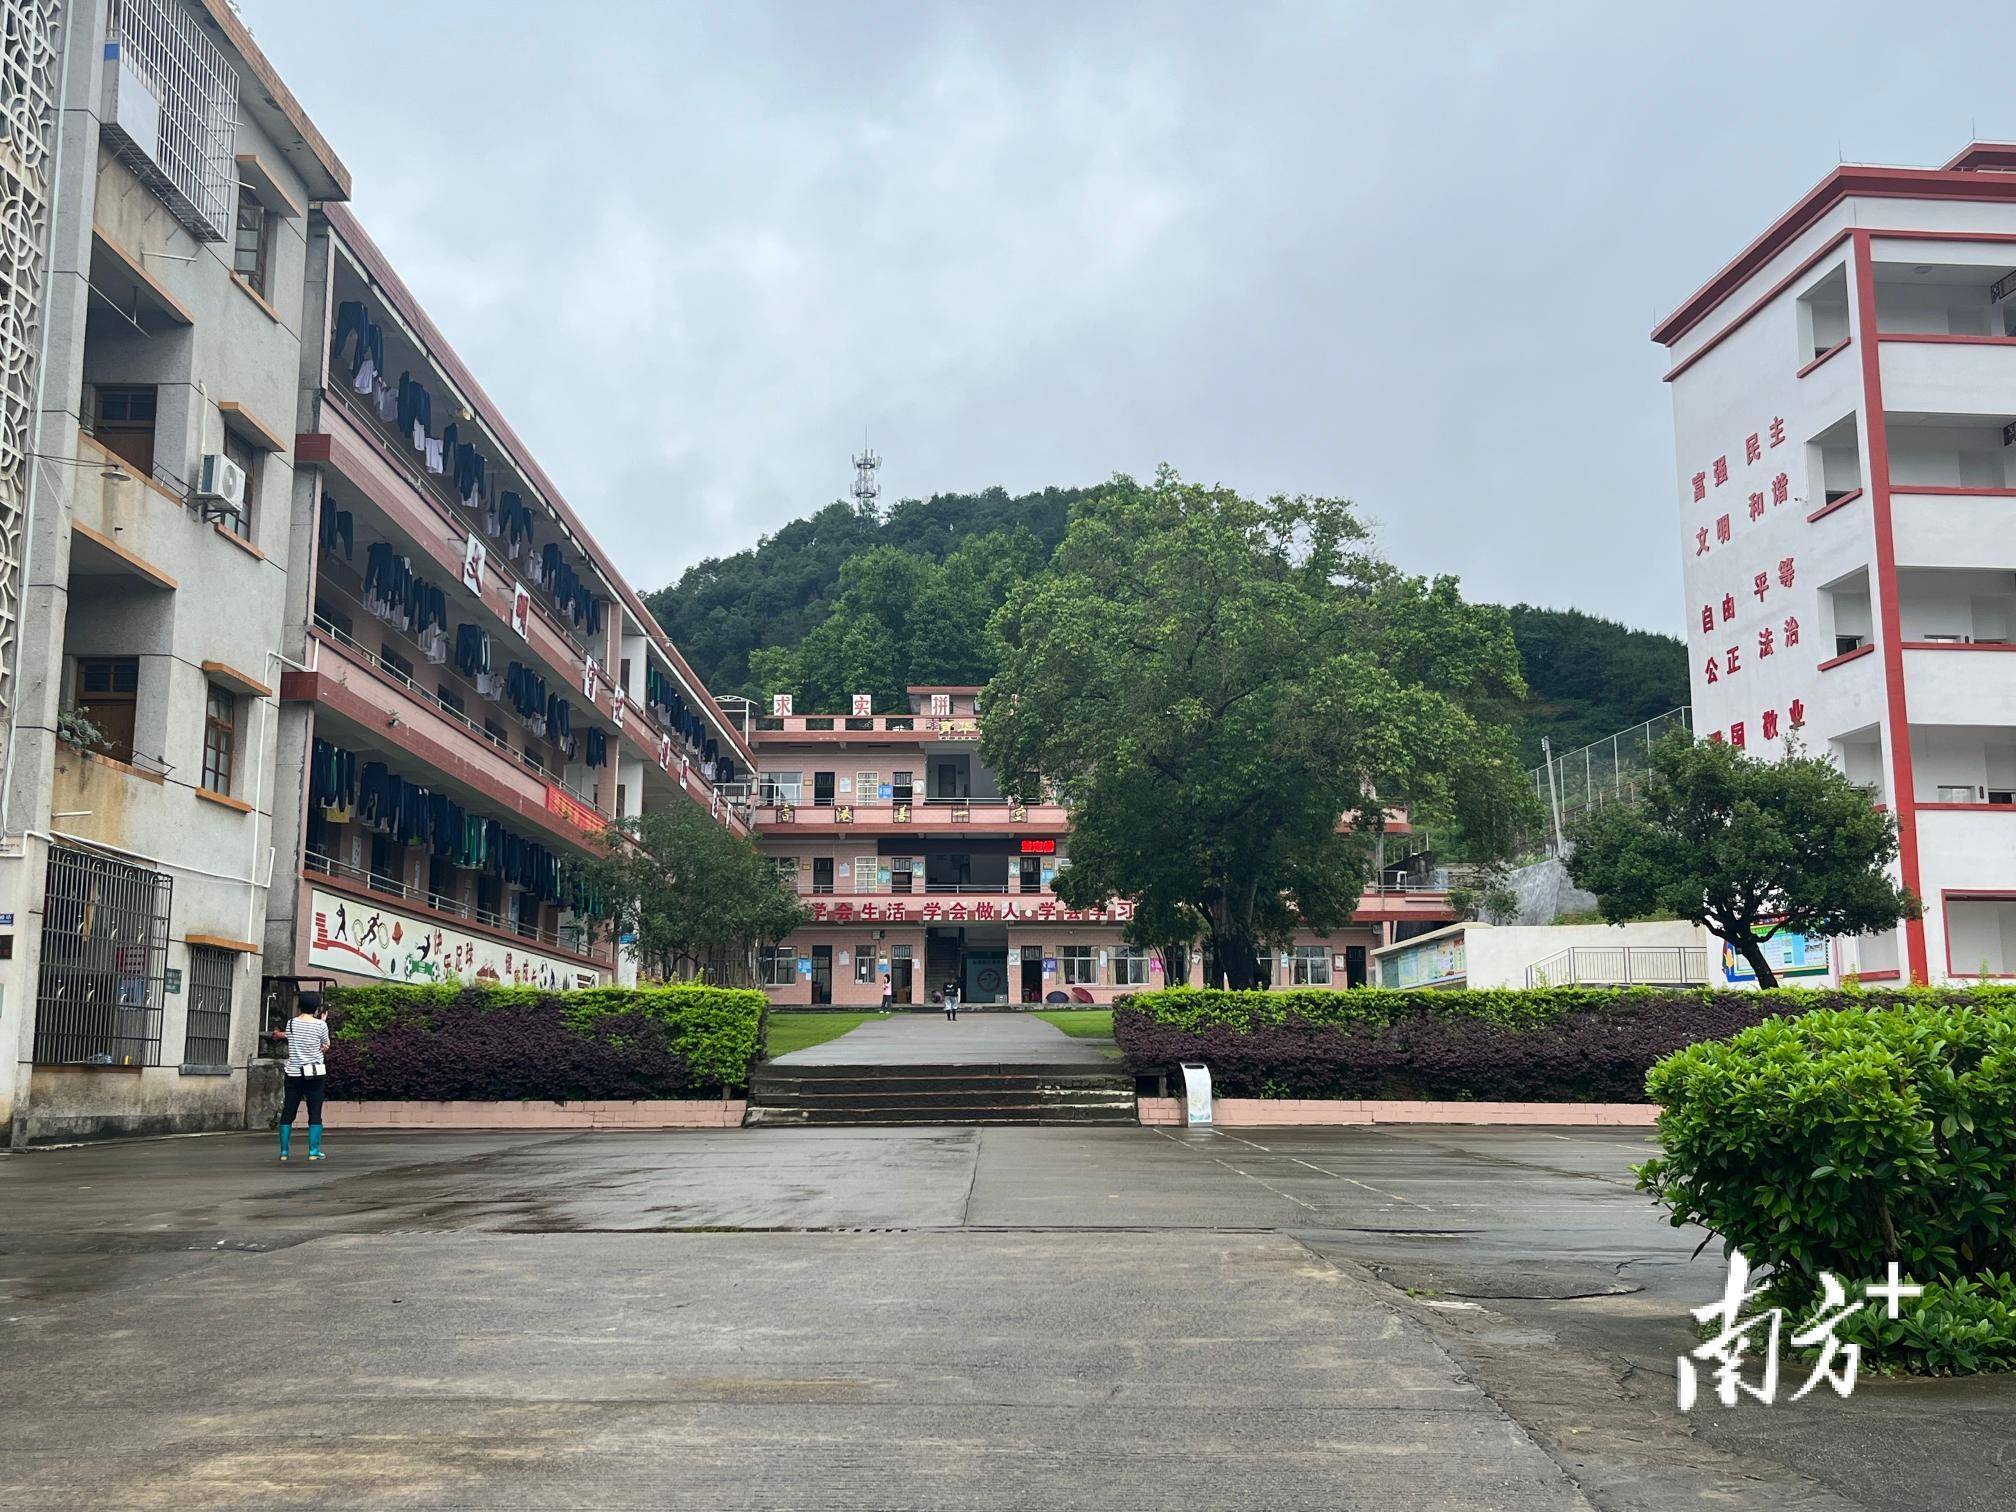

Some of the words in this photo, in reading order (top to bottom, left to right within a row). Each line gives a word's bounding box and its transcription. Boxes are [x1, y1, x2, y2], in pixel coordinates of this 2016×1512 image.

[1692, 455, 1728, 503] 富强
[1745, 416, 1786, 464] 民主
[1696, 514, 1730, 555] 文明
[1749, 472, 1789, 521] 和谐
[1702, 593, 1735, 633] 自由
[1754, 557, 1795, 601] 平等
[1705, 646, 1741, 684] 公正
[1759, 616, 1800, 659] 法治
[1762, 698, 1805, 740] 敬业
[812, 902, 905, 920] 学会生活
[923, 902, 1019, 920] 学会做人
